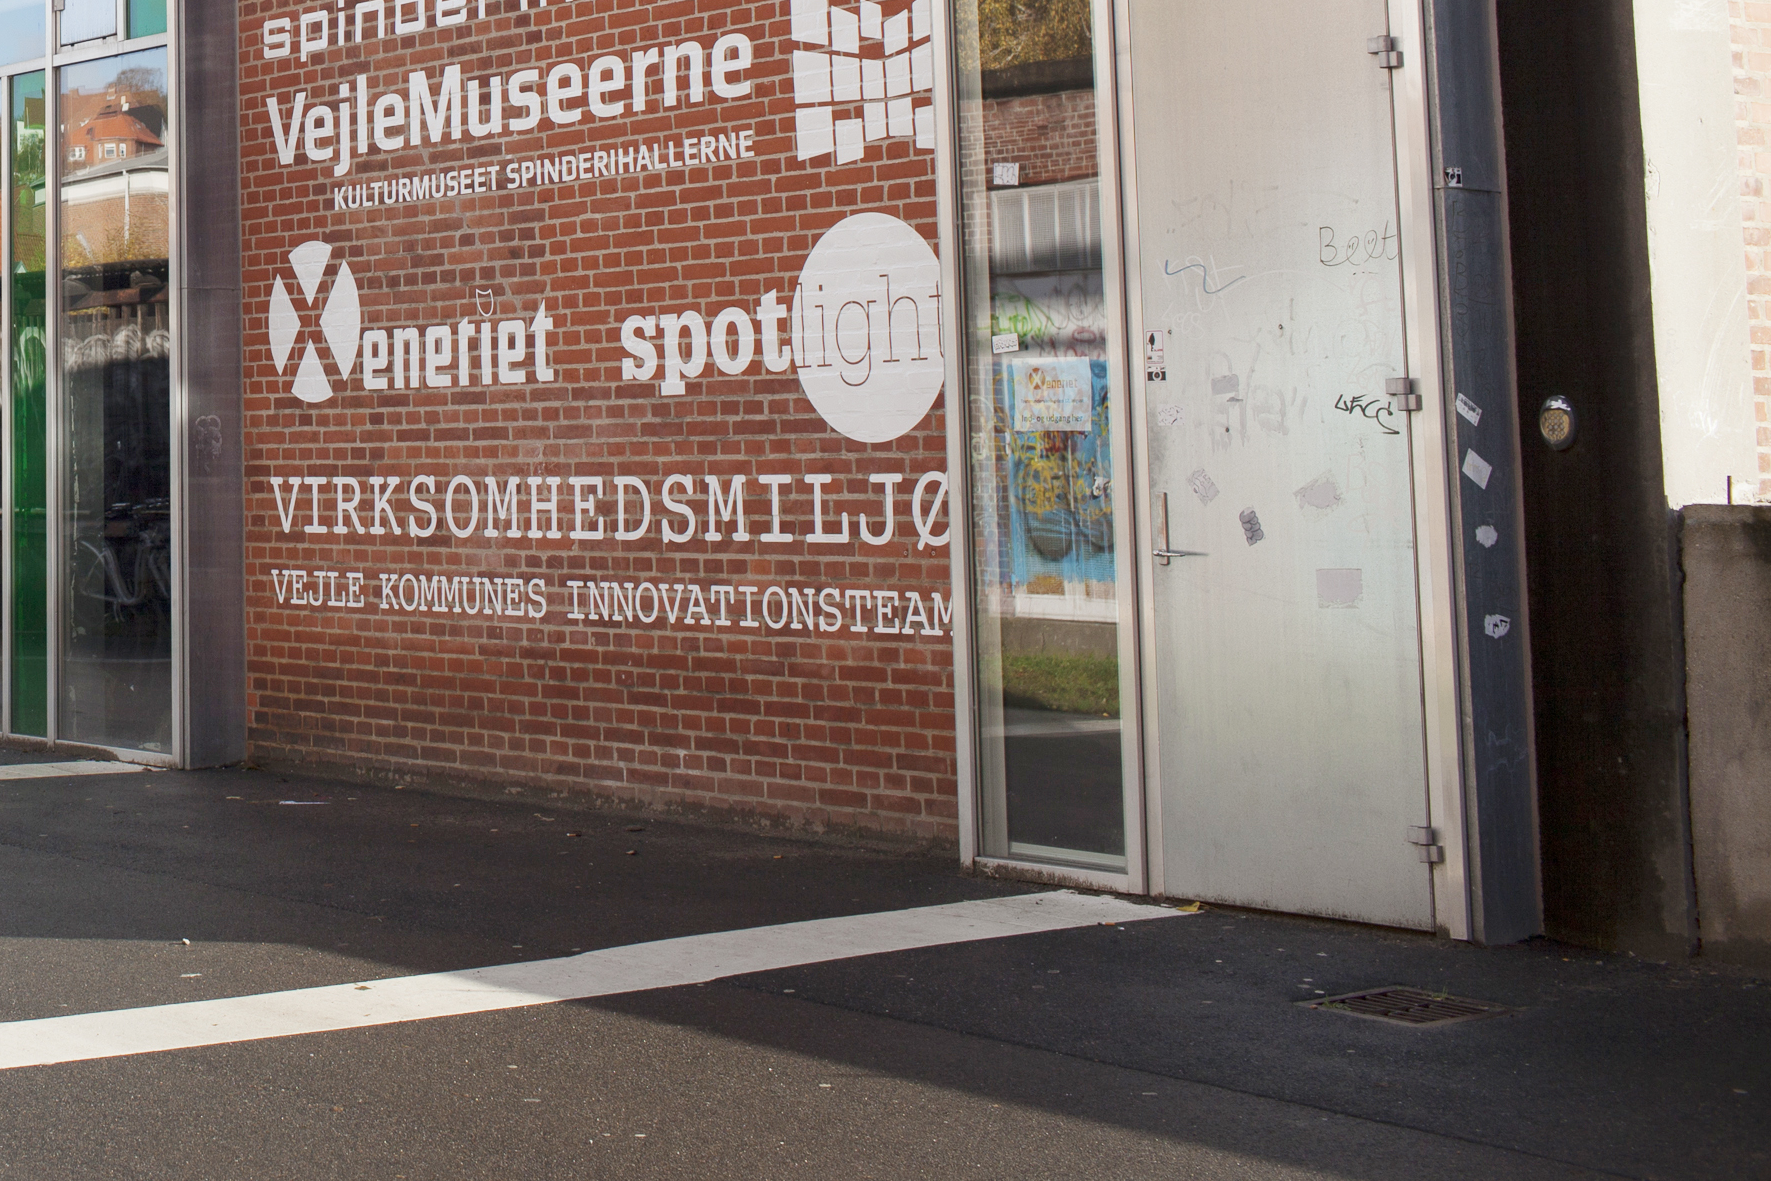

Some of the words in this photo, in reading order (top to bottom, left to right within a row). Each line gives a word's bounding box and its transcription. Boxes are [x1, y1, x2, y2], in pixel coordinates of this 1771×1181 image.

[266, 33, 752, 177] VejleMuseerne
[334, 165, 500, 210] KULTURMUSEET
[506, 130, 755, 189] SPINDERIHALLERNE
[270, 471, 950, 551] VIRKSOMHEDSMILJØ
[271, 569, 364, 607] VEJLE
[379, 573, 547, 618] KOMMUNES
[566, 580, 954, 636] INNOVATIONSTEAM
